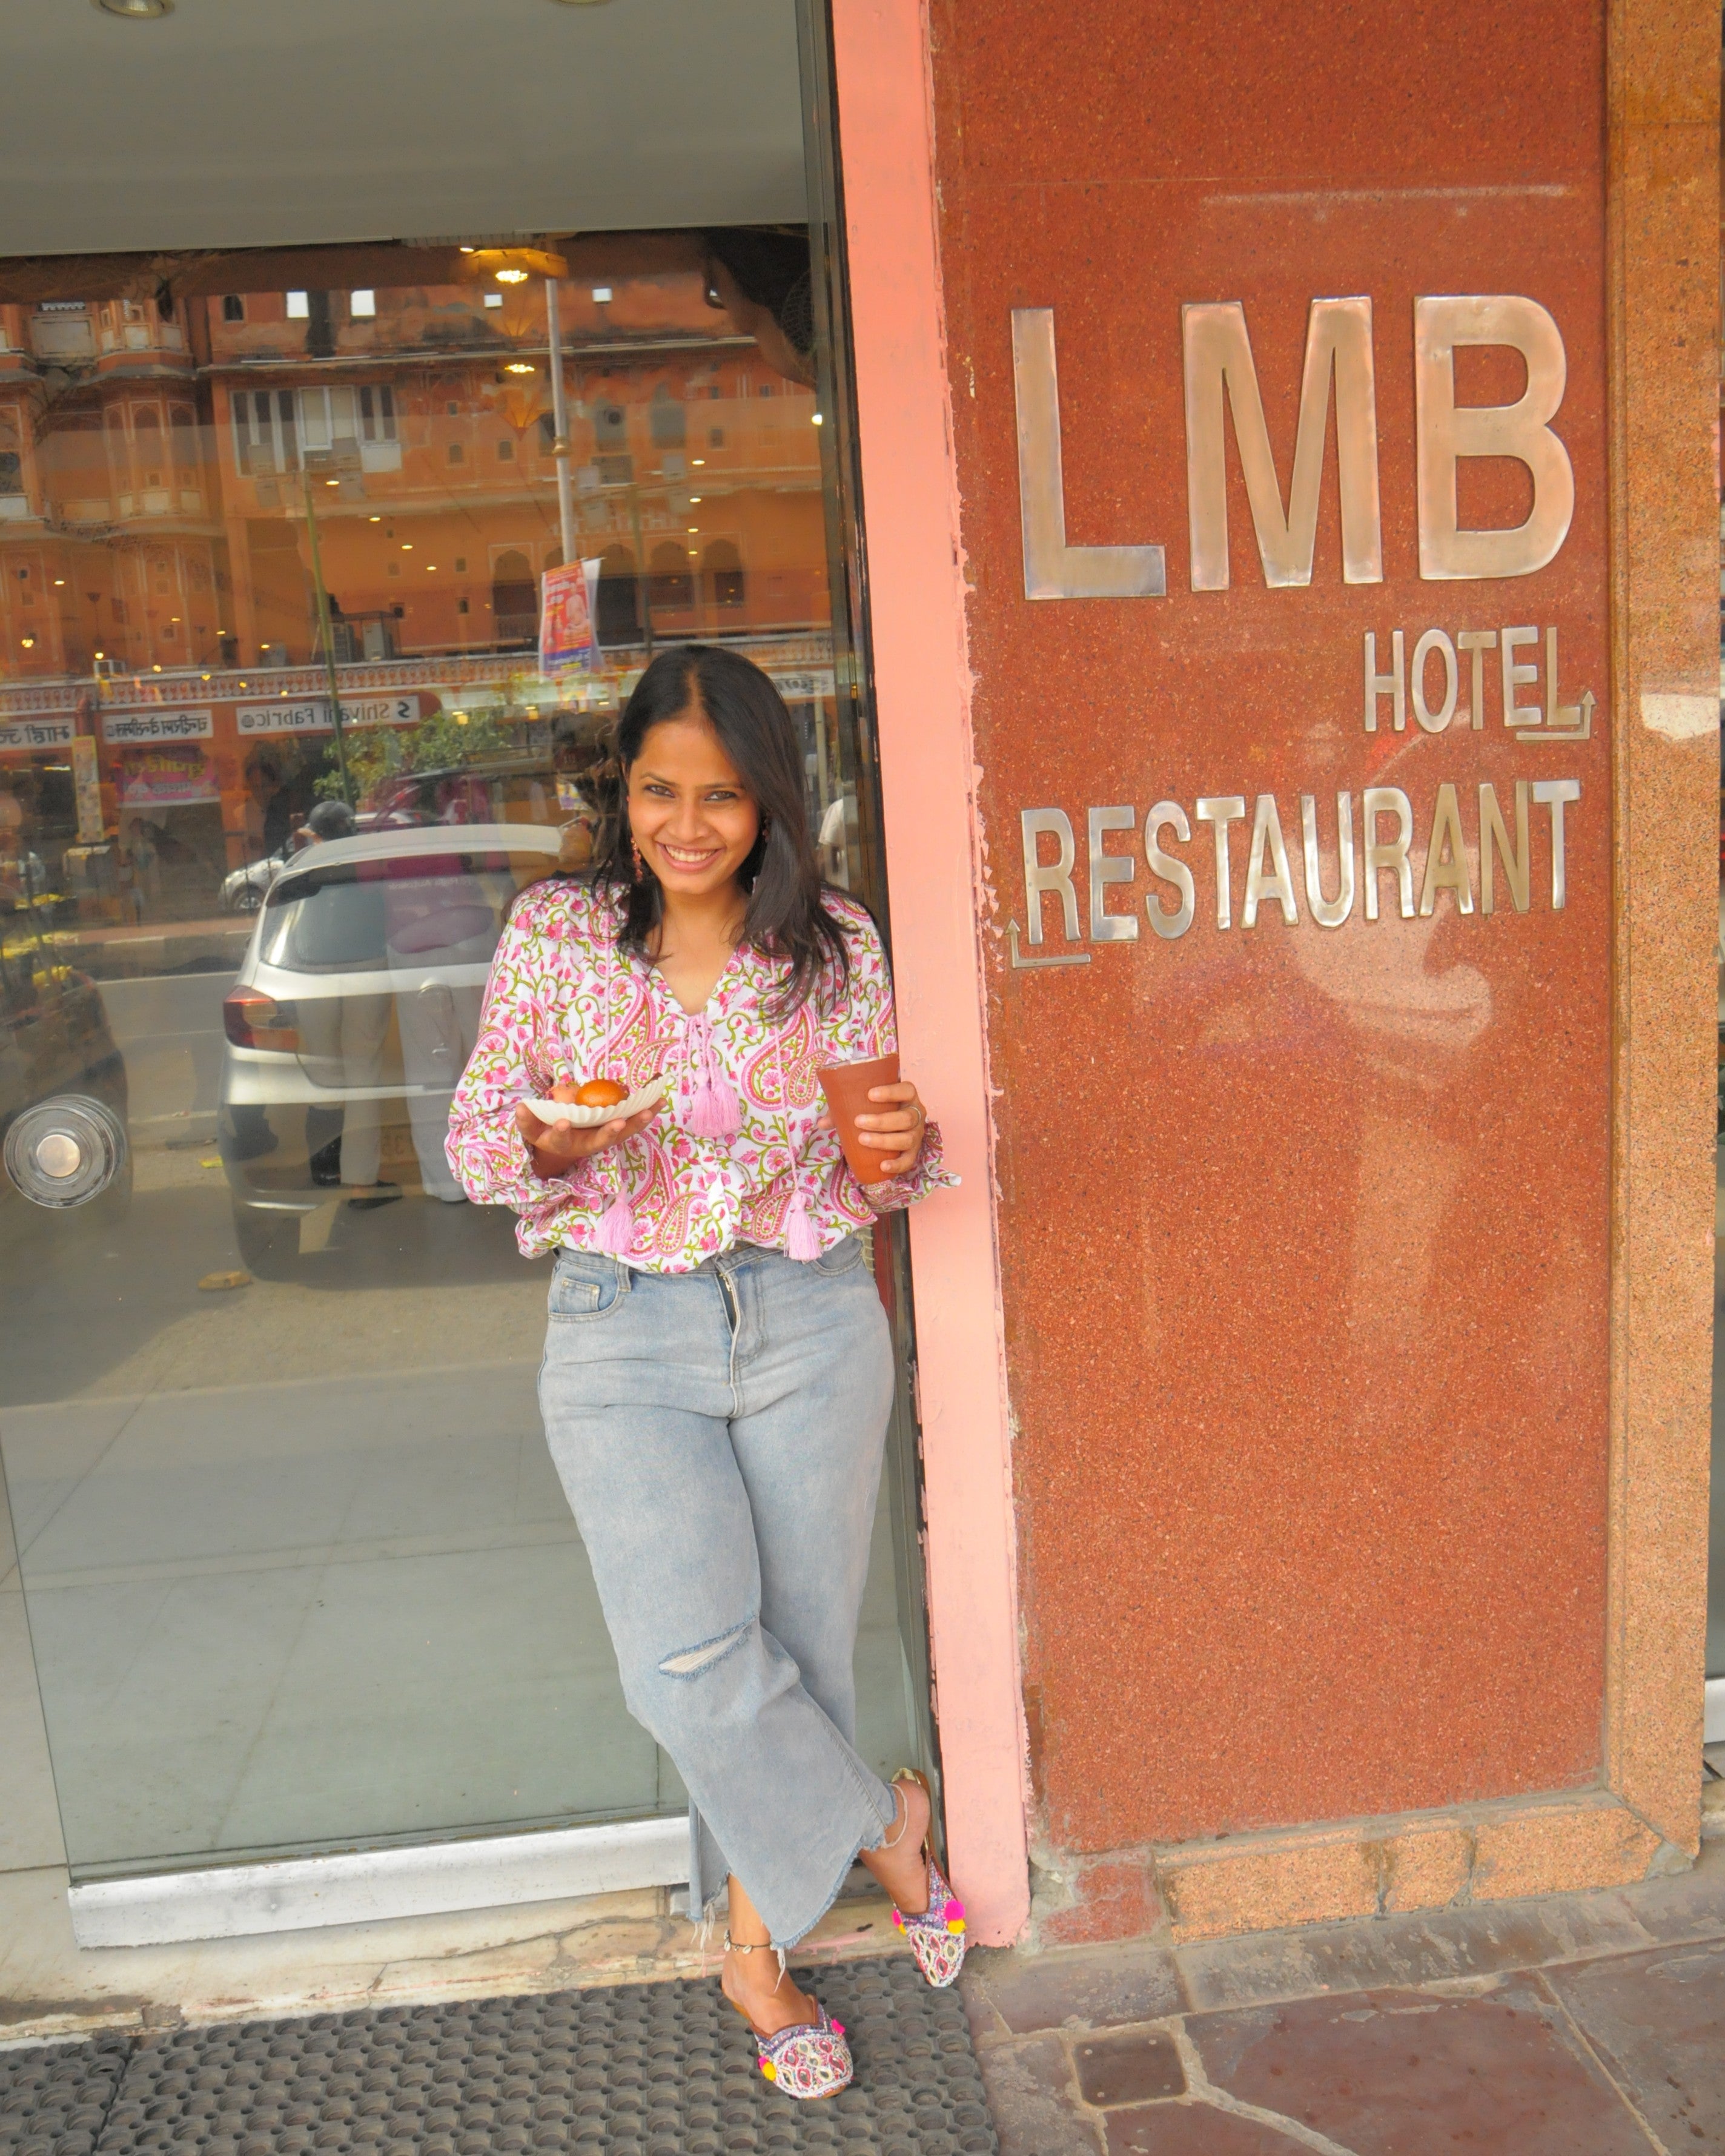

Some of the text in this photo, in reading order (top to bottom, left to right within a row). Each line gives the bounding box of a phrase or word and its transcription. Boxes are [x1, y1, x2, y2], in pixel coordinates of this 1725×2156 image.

[1010, 295, 1576, 601] LMB
[1363, 626, 1580, 733] HOTEL
[1021, 779, 1580, 945] RESTAURANT
